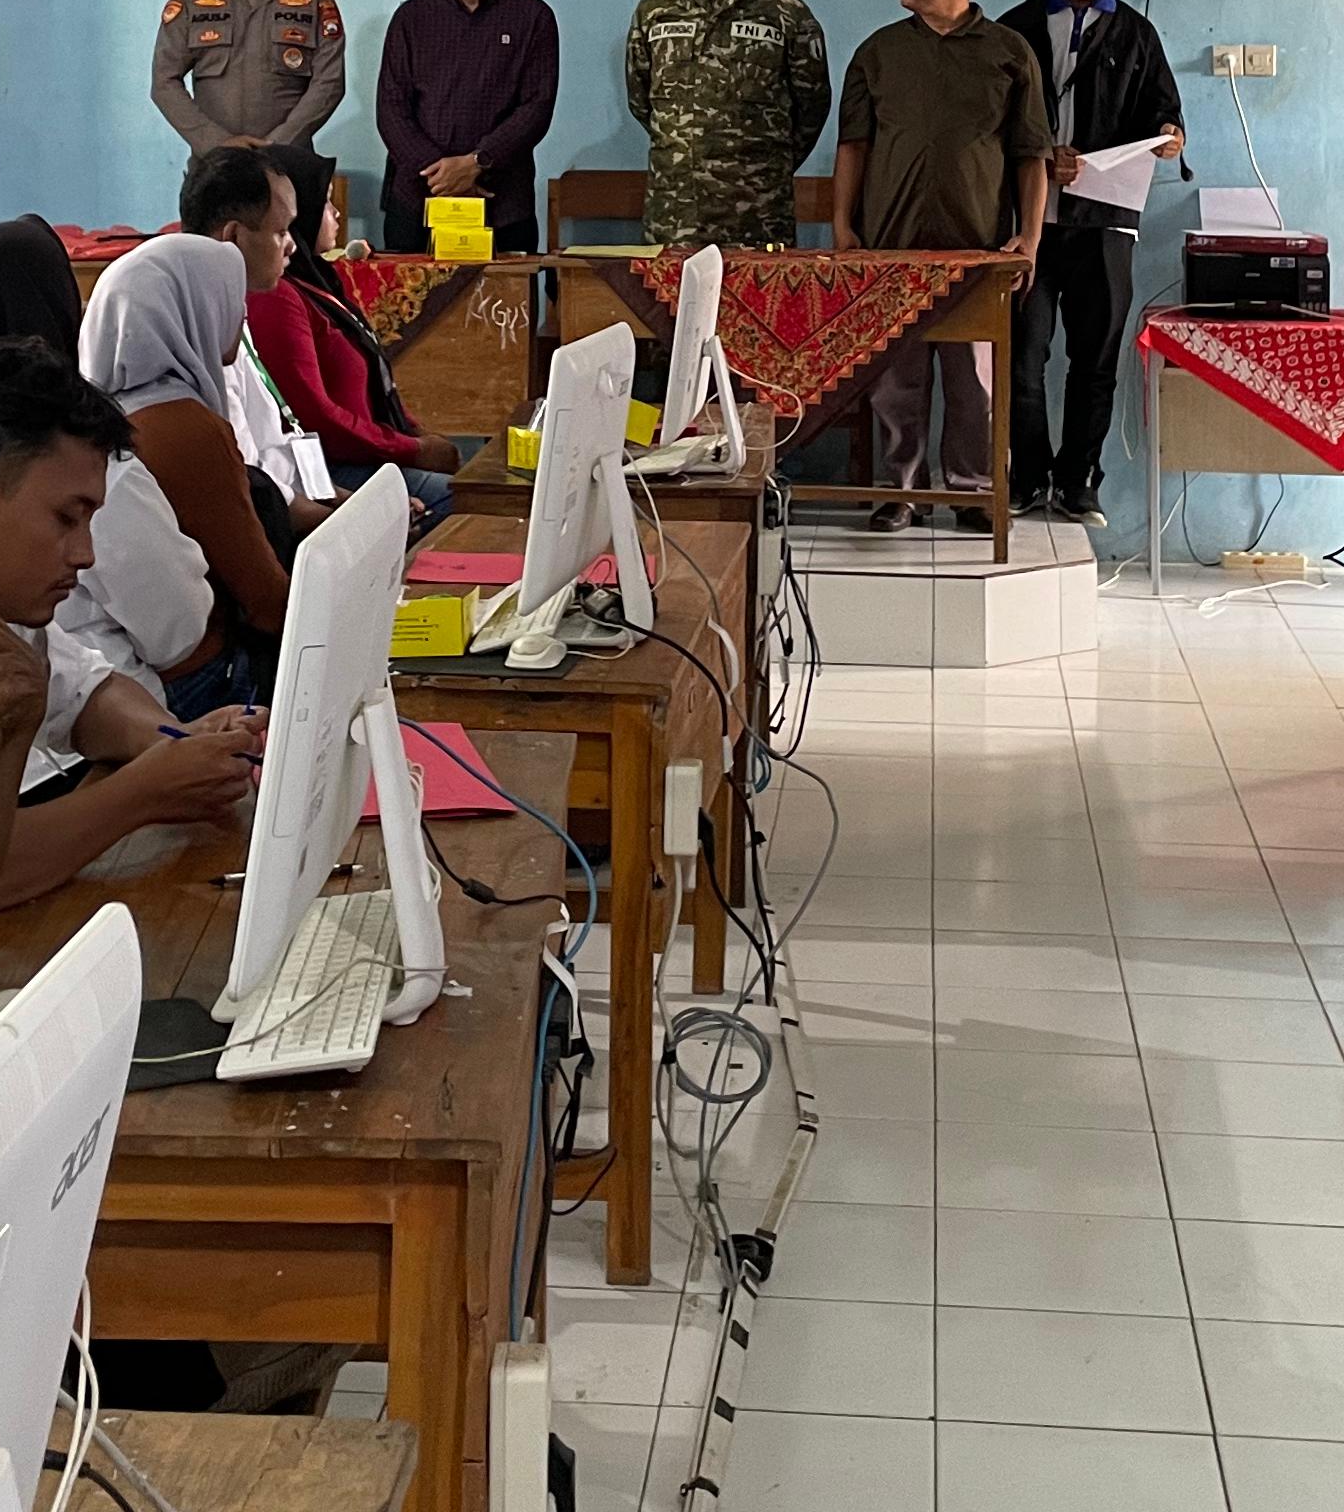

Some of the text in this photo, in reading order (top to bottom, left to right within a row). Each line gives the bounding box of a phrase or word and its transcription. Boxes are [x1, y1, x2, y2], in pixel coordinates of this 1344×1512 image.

[274, 11, 314, 24] POLRI
[735, 24, 782, 42] TNI AD
[51, 1101, 111, 1211] acer
